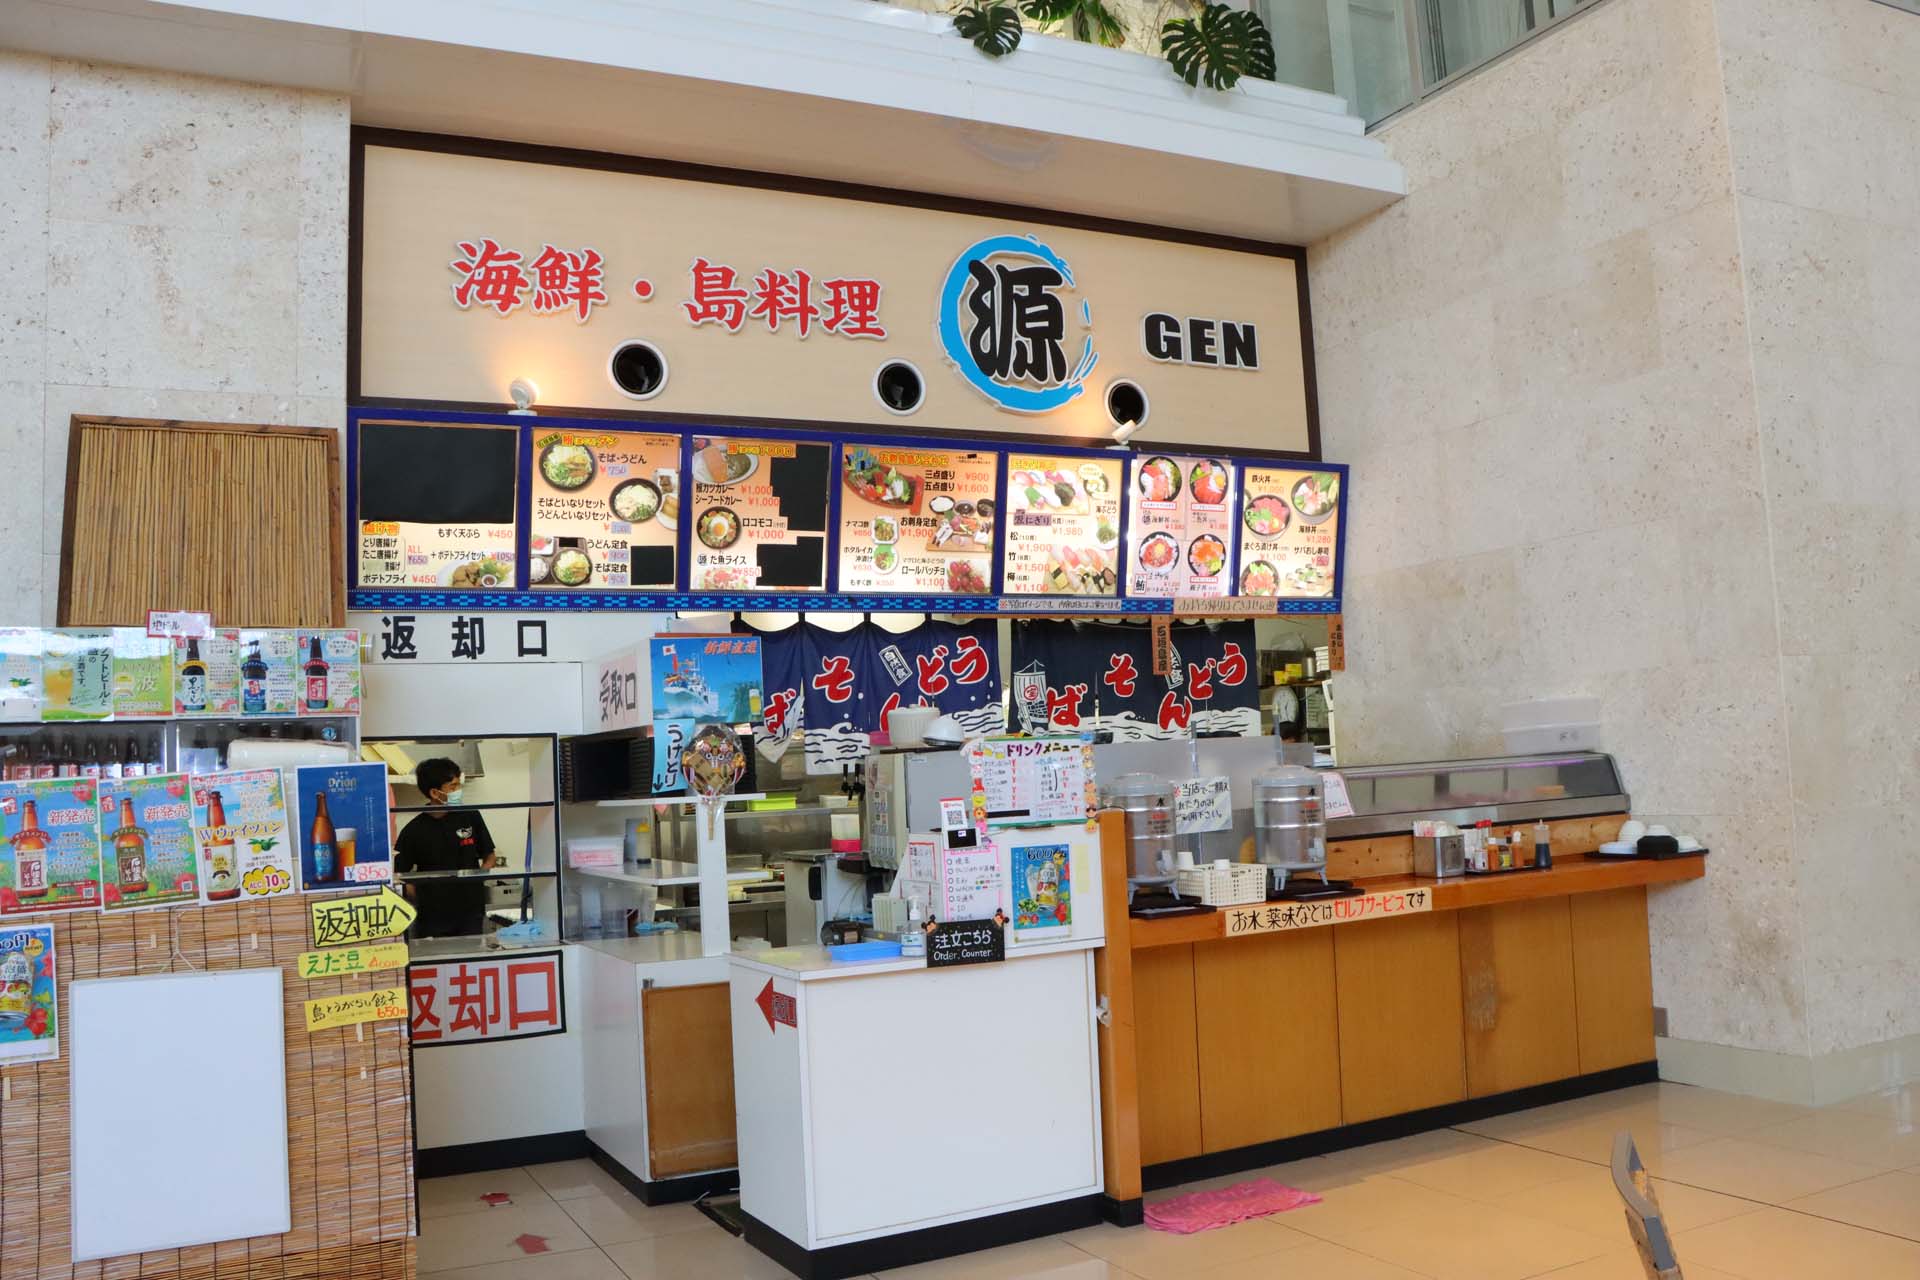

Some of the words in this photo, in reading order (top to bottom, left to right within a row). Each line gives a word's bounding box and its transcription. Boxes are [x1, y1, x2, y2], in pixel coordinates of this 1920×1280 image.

[450, 236, 888, 340] 海鮮・島料理
[968, 258, 1068, 383] 源
[1143, 313, 1260, 370] GEN
[597, 453, 647, 465] そば・うどん
[925, 470, 955, 480] 三点盛り
[925, 484, 955, 494] 五点盛り
[537, 498, 606, 509] そばといなりセット
[536, 511, 612, 521] うどんといなりセット
[742, 517, 773, 528] ロコモコ
[901, 517, 938, 528] お刺身定食
[587, 540, 628, 550] うどん定食
[594, 563, 628, 574] そば定食
[382, 616, 547, 660] 返却口
